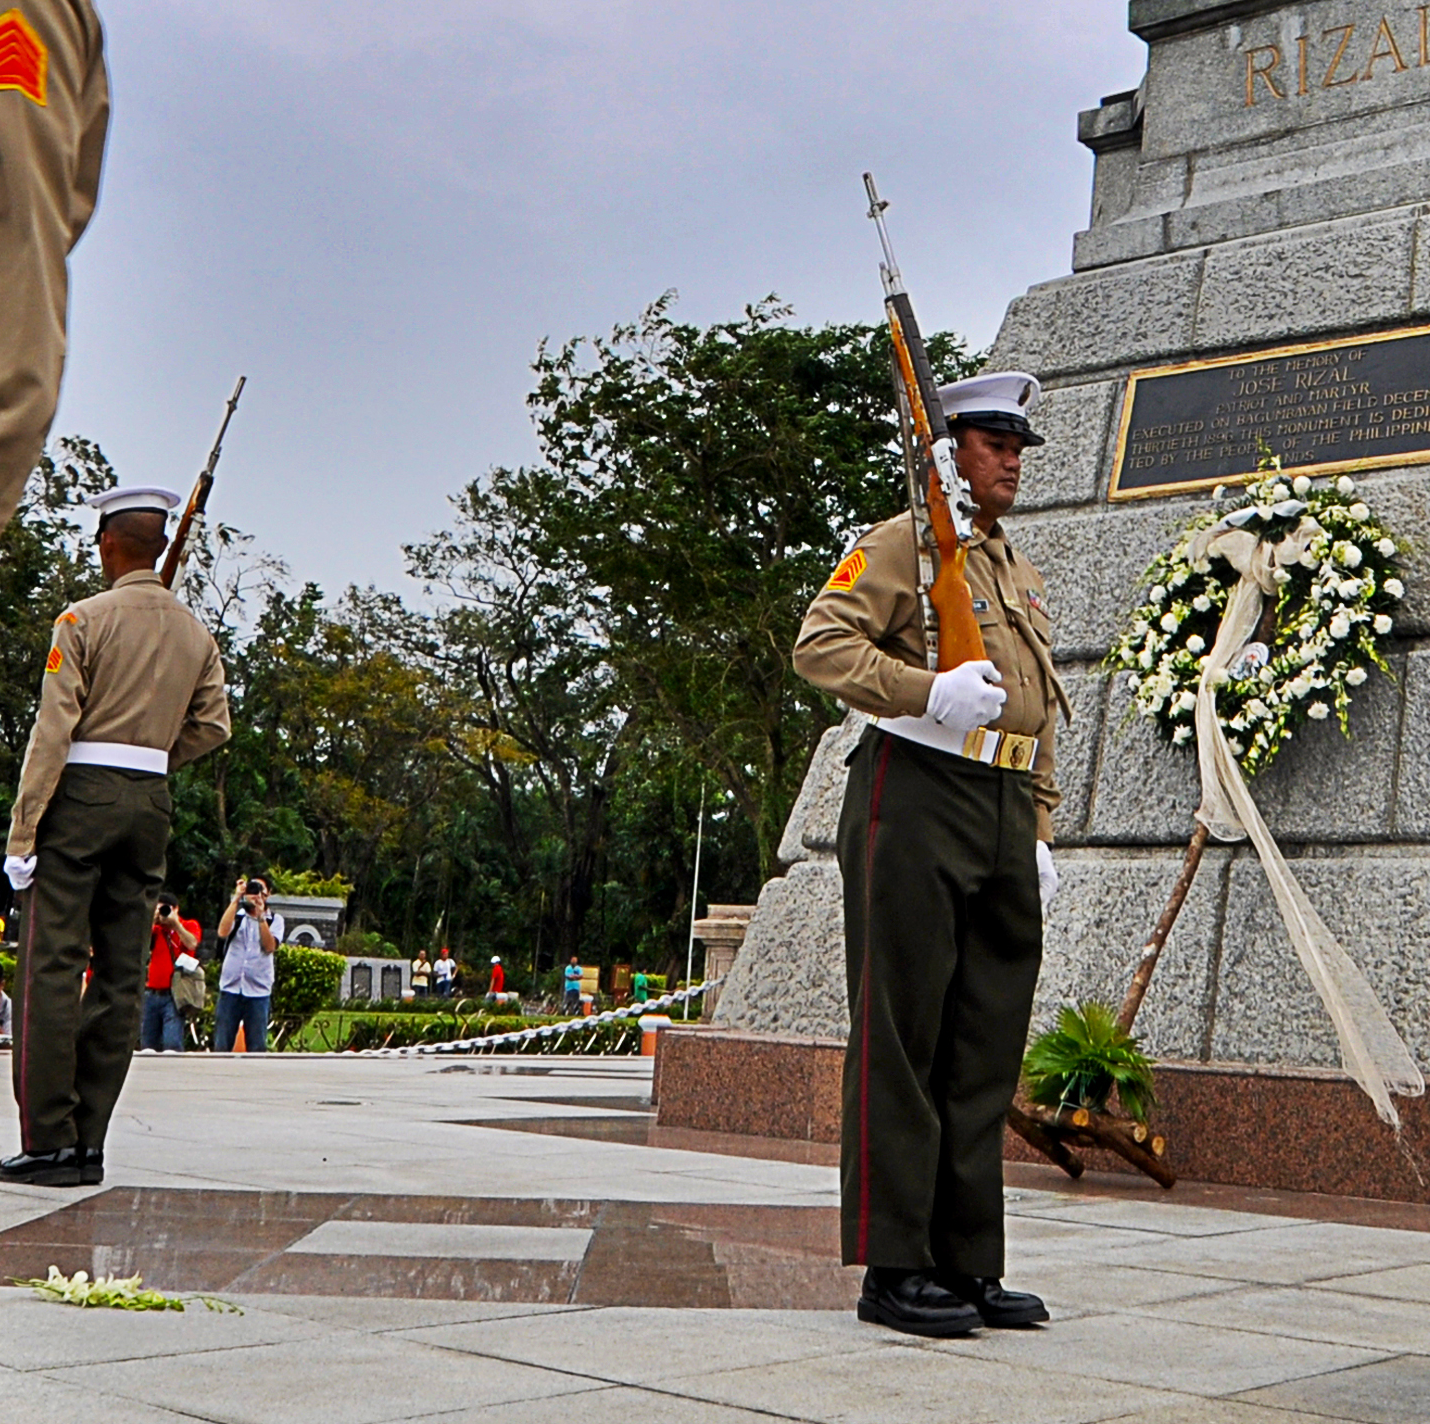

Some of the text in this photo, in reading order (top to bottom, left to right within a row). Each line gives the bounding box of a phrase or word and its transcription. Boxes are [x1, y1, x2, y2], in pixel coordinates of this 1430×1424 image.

[1229, 349, 1367, 381] TO THE MEMORY OF
[1295, 366, 1357, 389] RIZAL
[1215, 381, 1370, 415] PATRIOT AND MARTYR
[1131, 435, 1199, 455] THIRTIETH
[1240, 426, 1272, 440] THIS
[1277, 413, 1362, 436] MONUMENT
[1369, 410, 1384, 424] IS
[1132, 420, 1204, 440] EXECUTED
[1210, 417, 1230, 429] ON
[1236, 402, 1328, 425] BAGUMBAYAN
[1332, 396, 1378, 413] FIELD
[1129, 455, 1155, 469] TED
[1160, 452, 1178, 465] BY
[1186, 447, 1214, 462] THE
[1282, 436, 1302, 450] OF
[1312, 431, 1341, 446] THE
[1251, 449, 1315, 467] ISNDS
